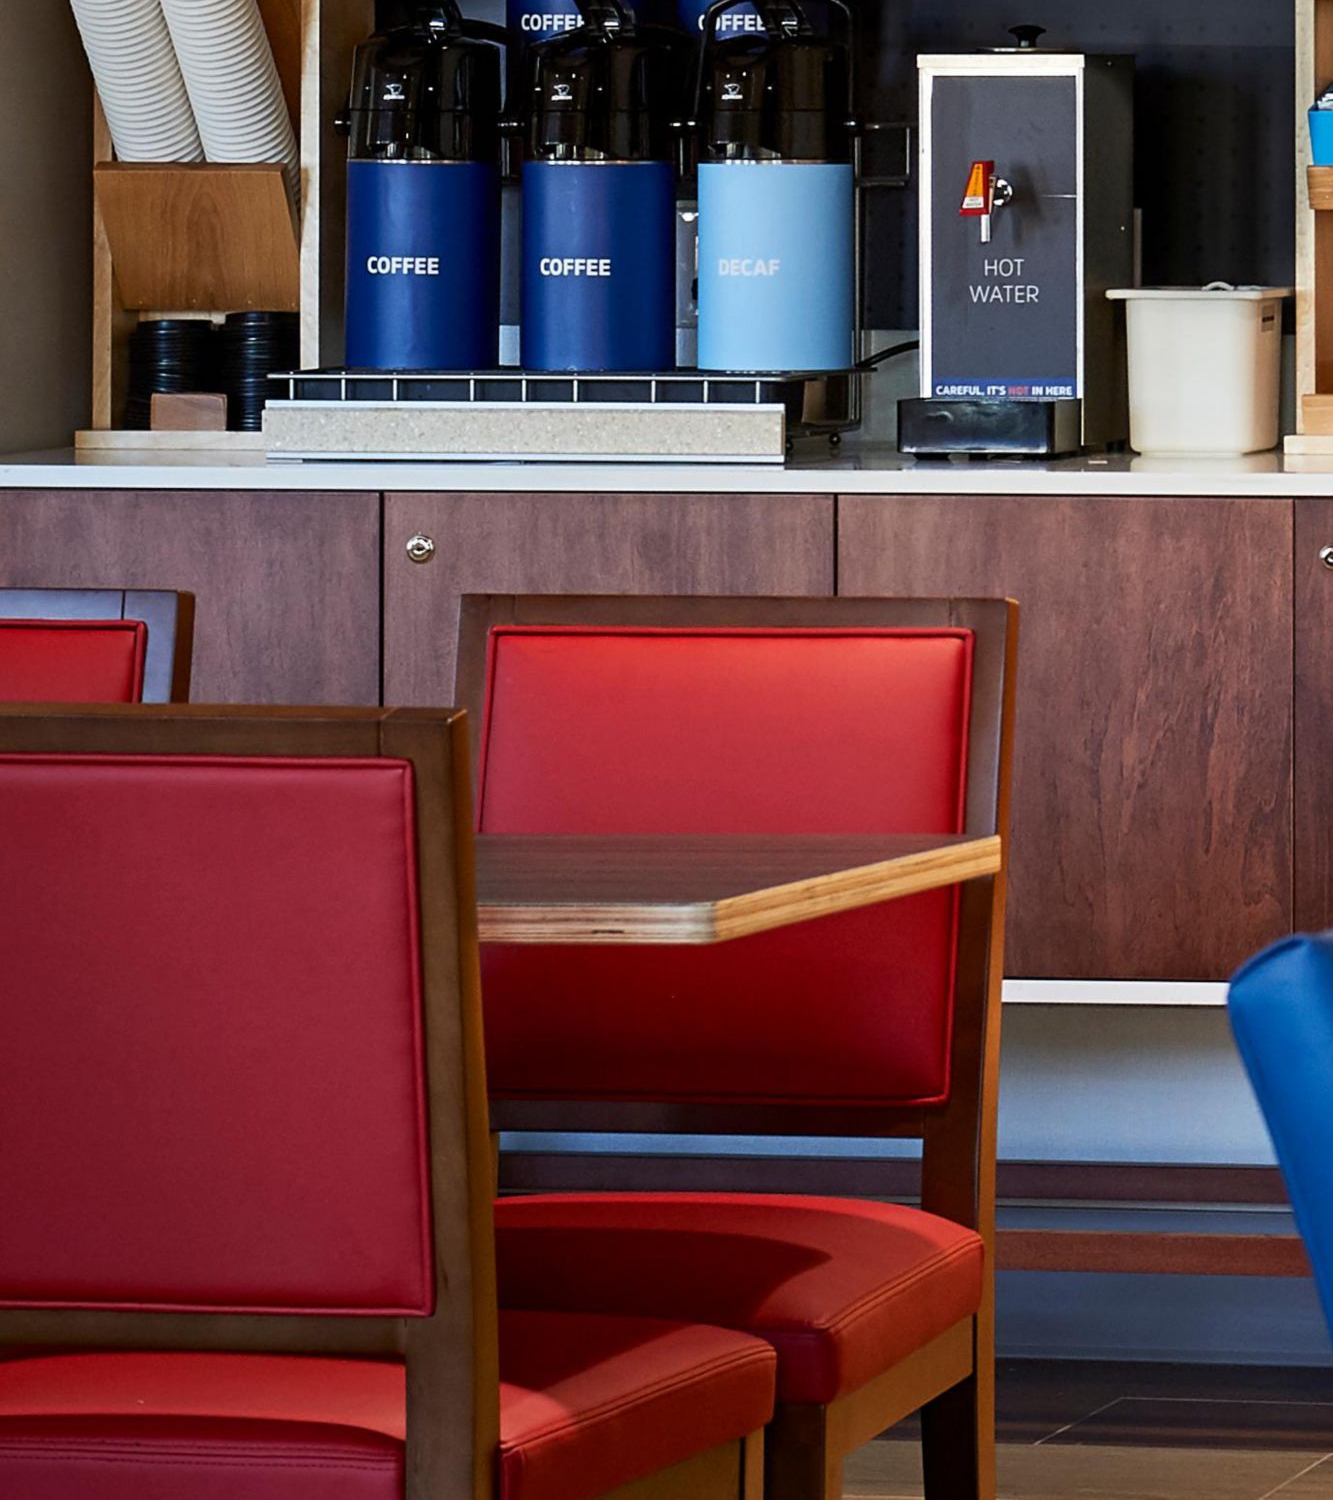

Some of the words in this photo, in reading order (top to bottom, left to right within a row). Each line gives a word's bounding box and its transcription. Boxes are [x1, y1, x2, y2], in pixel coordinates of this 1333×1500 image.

[367, 256, 439, 275] COFFEE
[540, 258, 611, 276] COFFEE
[718, 259, 781, 276] DECAF
[984, 259, 1025, 277] HOT
[969, 285, 1040, 303] WATER
[936, 385, 985, 397] CAREFUL,
[987, 385, 1006, 396] IT'S
[1031, 385, 1043, 396] IN
[1045, 385, 1072, 396] HERE
